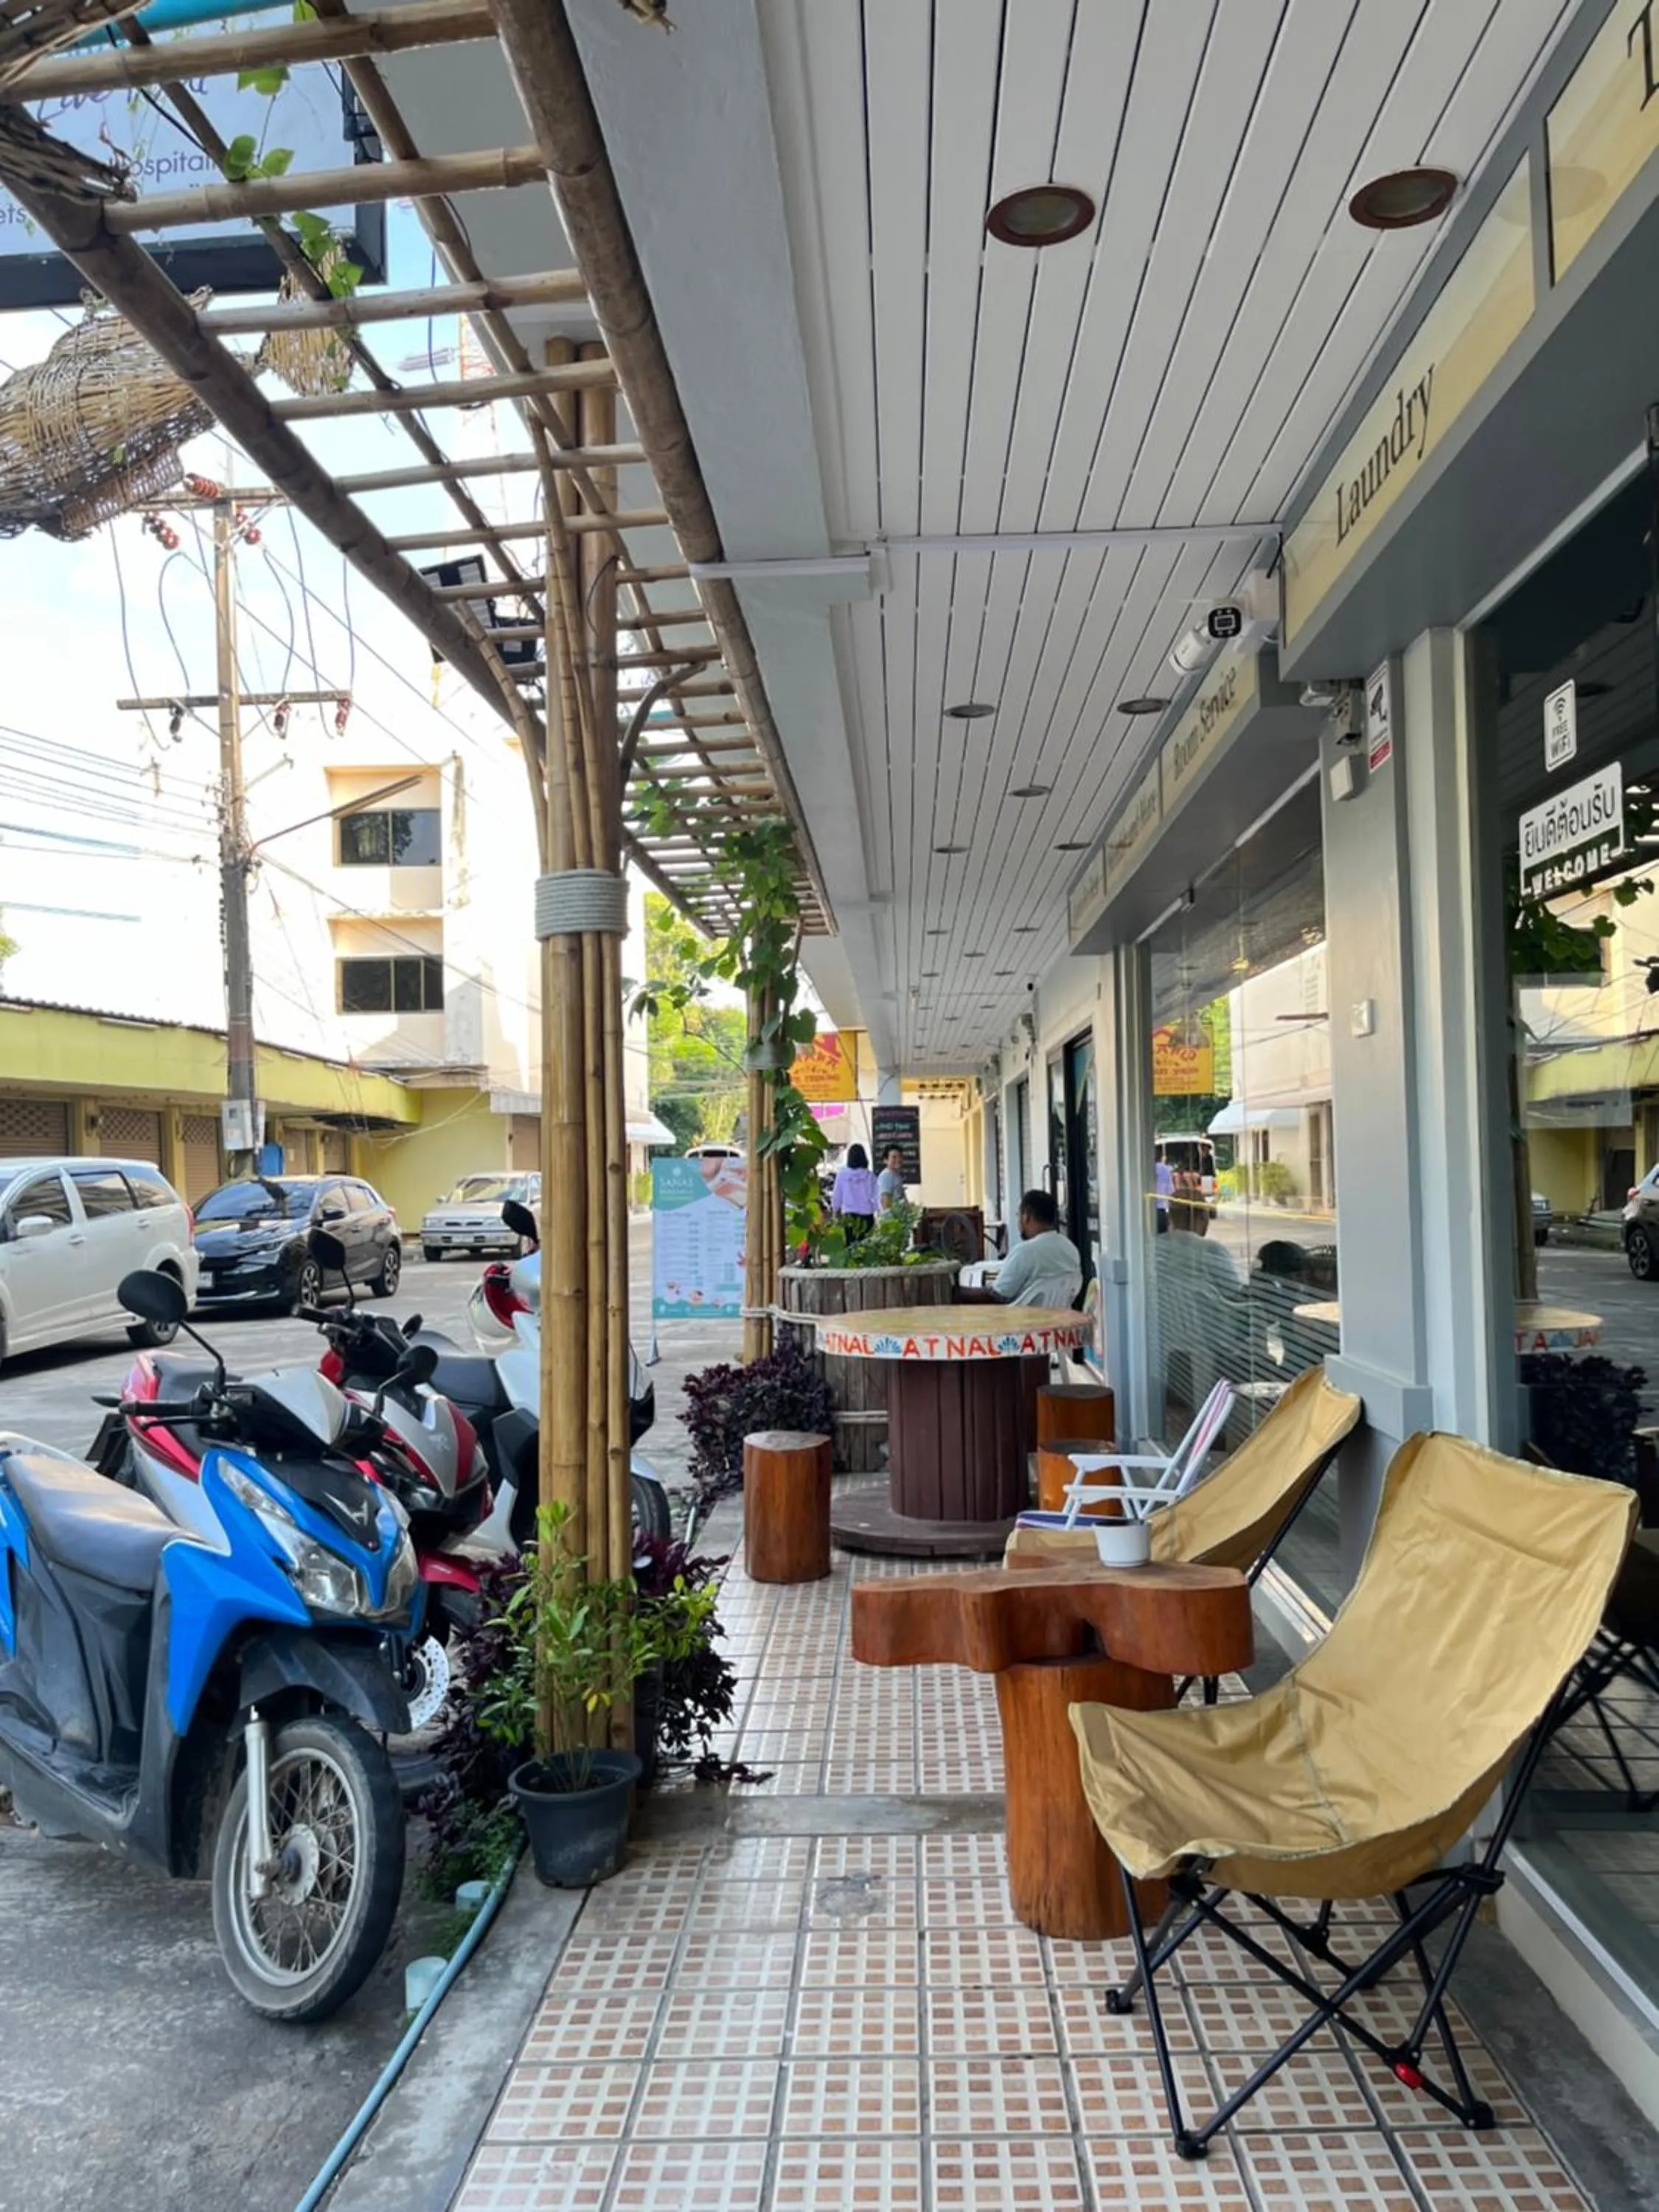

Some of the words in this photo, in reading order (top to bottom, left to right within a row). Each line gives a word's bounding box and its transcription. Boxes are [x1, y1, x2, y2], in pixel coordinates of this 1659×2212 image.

[1336, 364, 1434, 548] Laundry
[1523, 782, 1615, 858] ยินดีต้อนรับ
[1531, 842, 1612, 896] WELCOME
